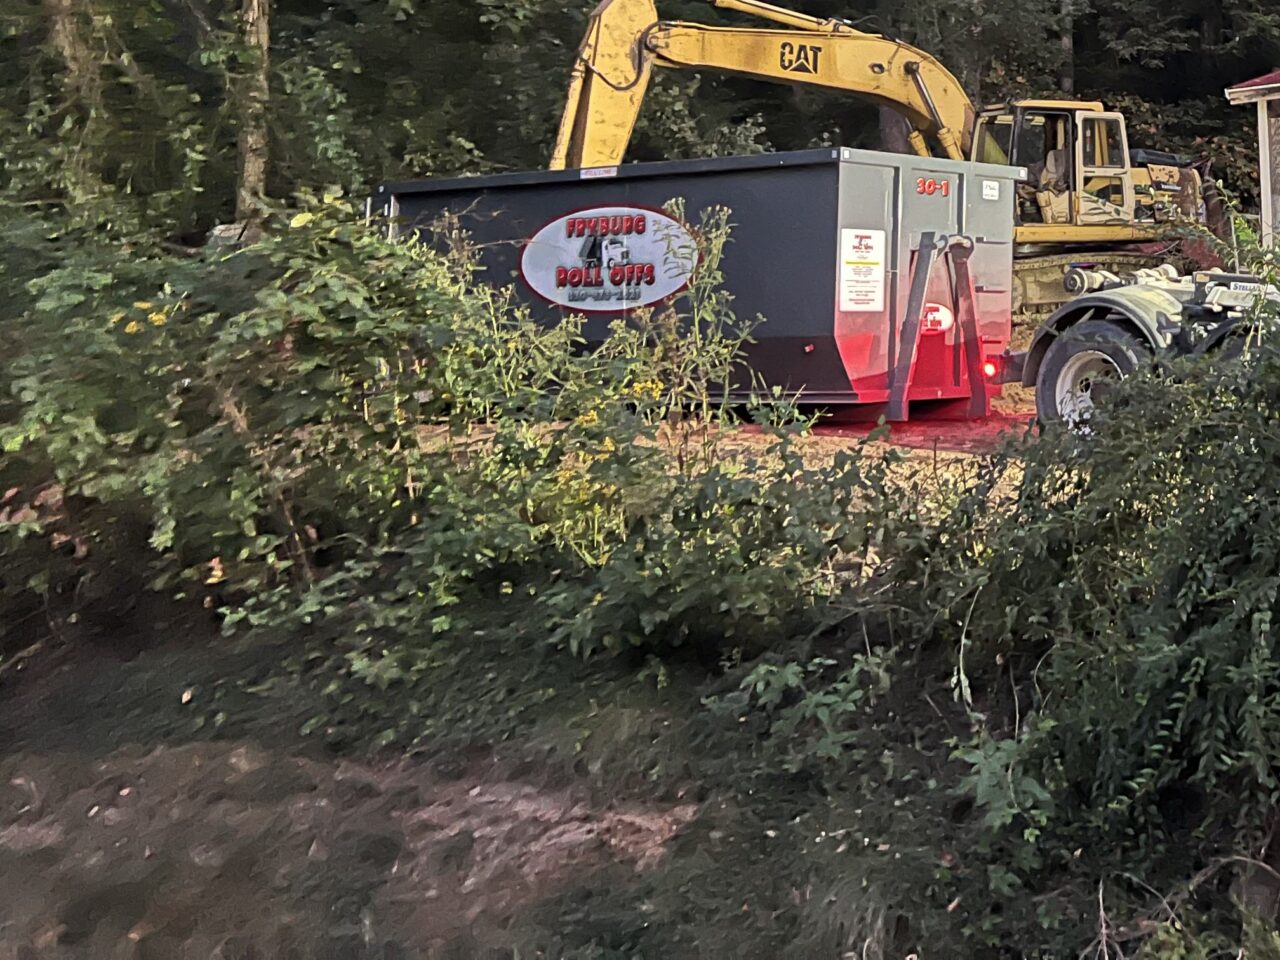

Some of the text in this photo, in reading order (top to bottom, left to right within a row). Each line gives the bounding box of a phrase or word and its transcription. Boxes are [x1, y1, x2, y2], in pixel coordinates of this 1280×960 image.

[780, 41, 822, 74] CAT
[916, 177, 949, 197] 30-1
[566, 215, 646, 238] FRYBURG
[556, 264, 656, 288] ROLL OFFS
